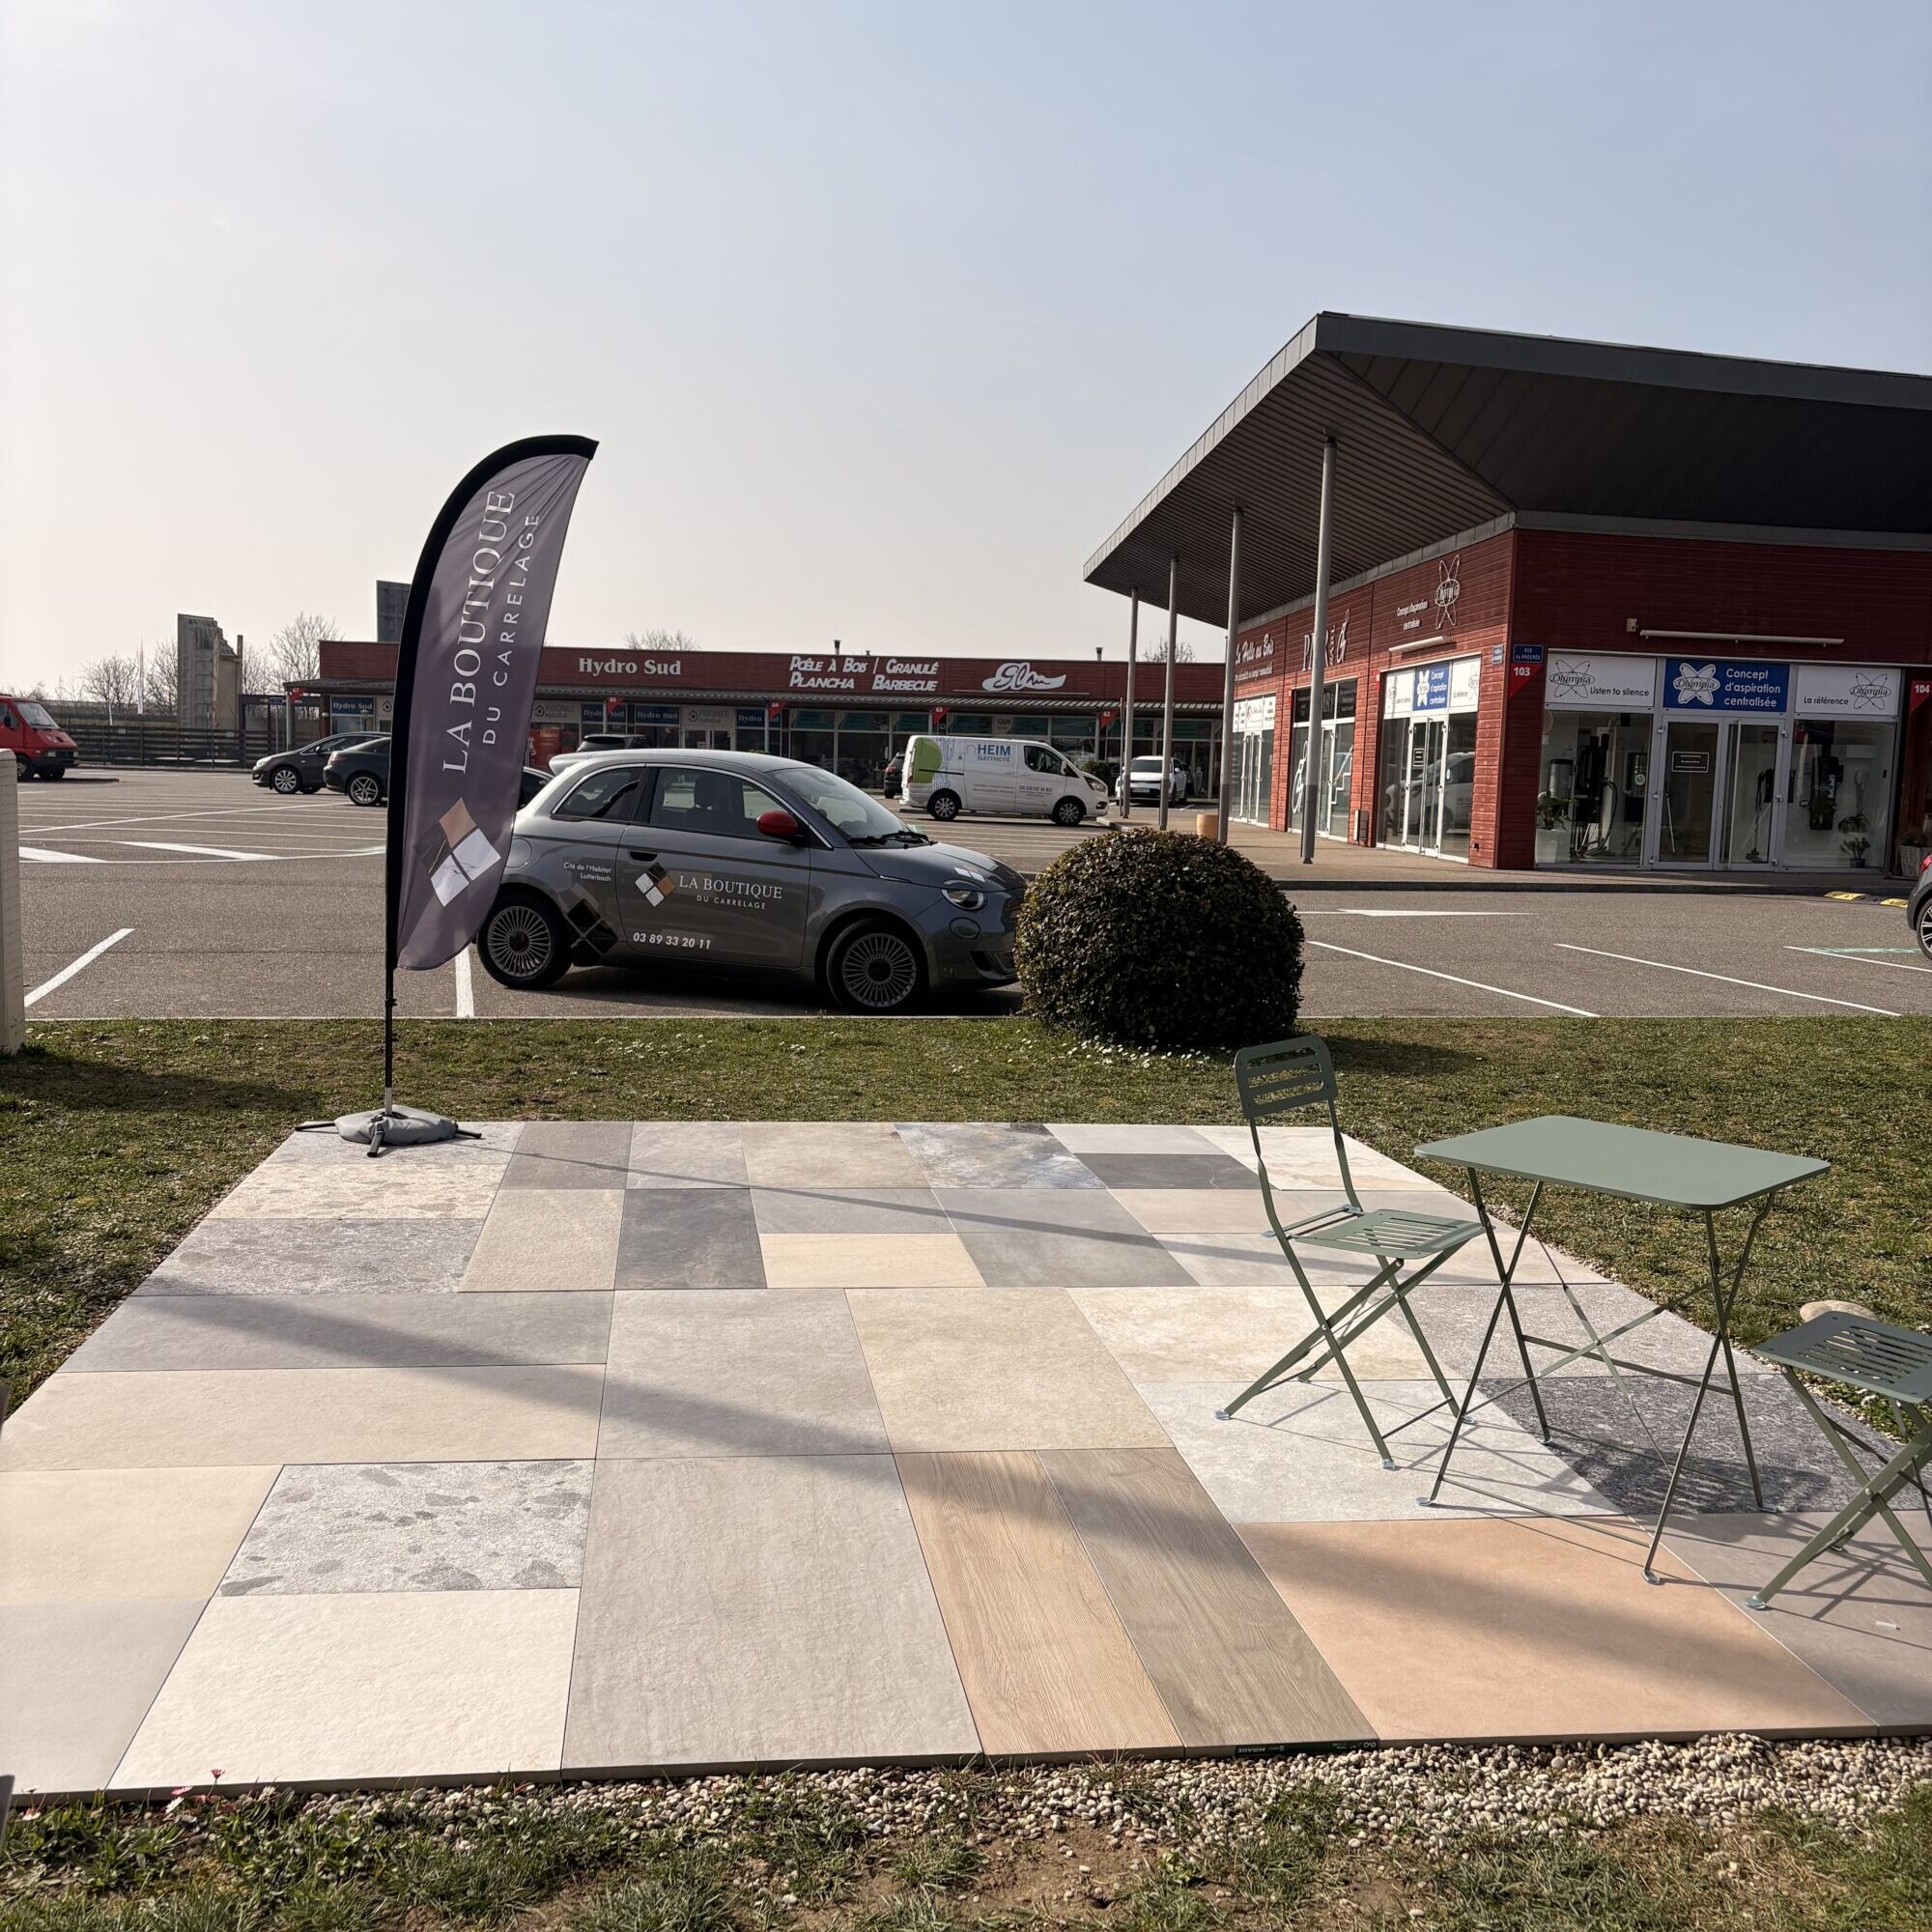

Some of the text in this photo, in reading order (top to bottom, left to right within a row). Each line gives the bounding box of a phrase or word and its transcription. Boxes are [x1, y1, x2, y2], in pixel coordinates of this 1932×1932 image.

[443, 491, 515, 775] LA BOUTIQUE
[483, 515, 540, 745] DU CARRELAGE
[579, 657, 681, 677] Hydro Sud
[886, 658, 940, 675] GRANULÉ
[1514, 666, 1531, 677] 103
[1552, 674, 1592, 686] Olympia
[1726, 668, 1769, 680] Concept
[789, 671, 939, 692] PLANCHA BARBECUE
[1677, 678, 1716, 691] Olympia
[1590, 687, 1650, 696] Listen to silence
[1725, 683, 1781, 695] d'aspiration
[1852, 686, 1889, 696] Olympia
[1915, 684, 1929, 694] 104
[332, 701, 373, 711] Hydro Sud
[1724, 696, 1777, 707] centralisée
[1813, 695, 1849, 705] référence
[738, 714, 762, 724] Hydro
[978, 744, 1011, 756] HEIM
[580, 872, 611, 882] Lutterbach
[679, 875, 783, 899] LA BOUTIQUE
[696, 895, 767, 910] DU CARRELAGE
[633, 931, 712, 950] 03 89 33 20 11
